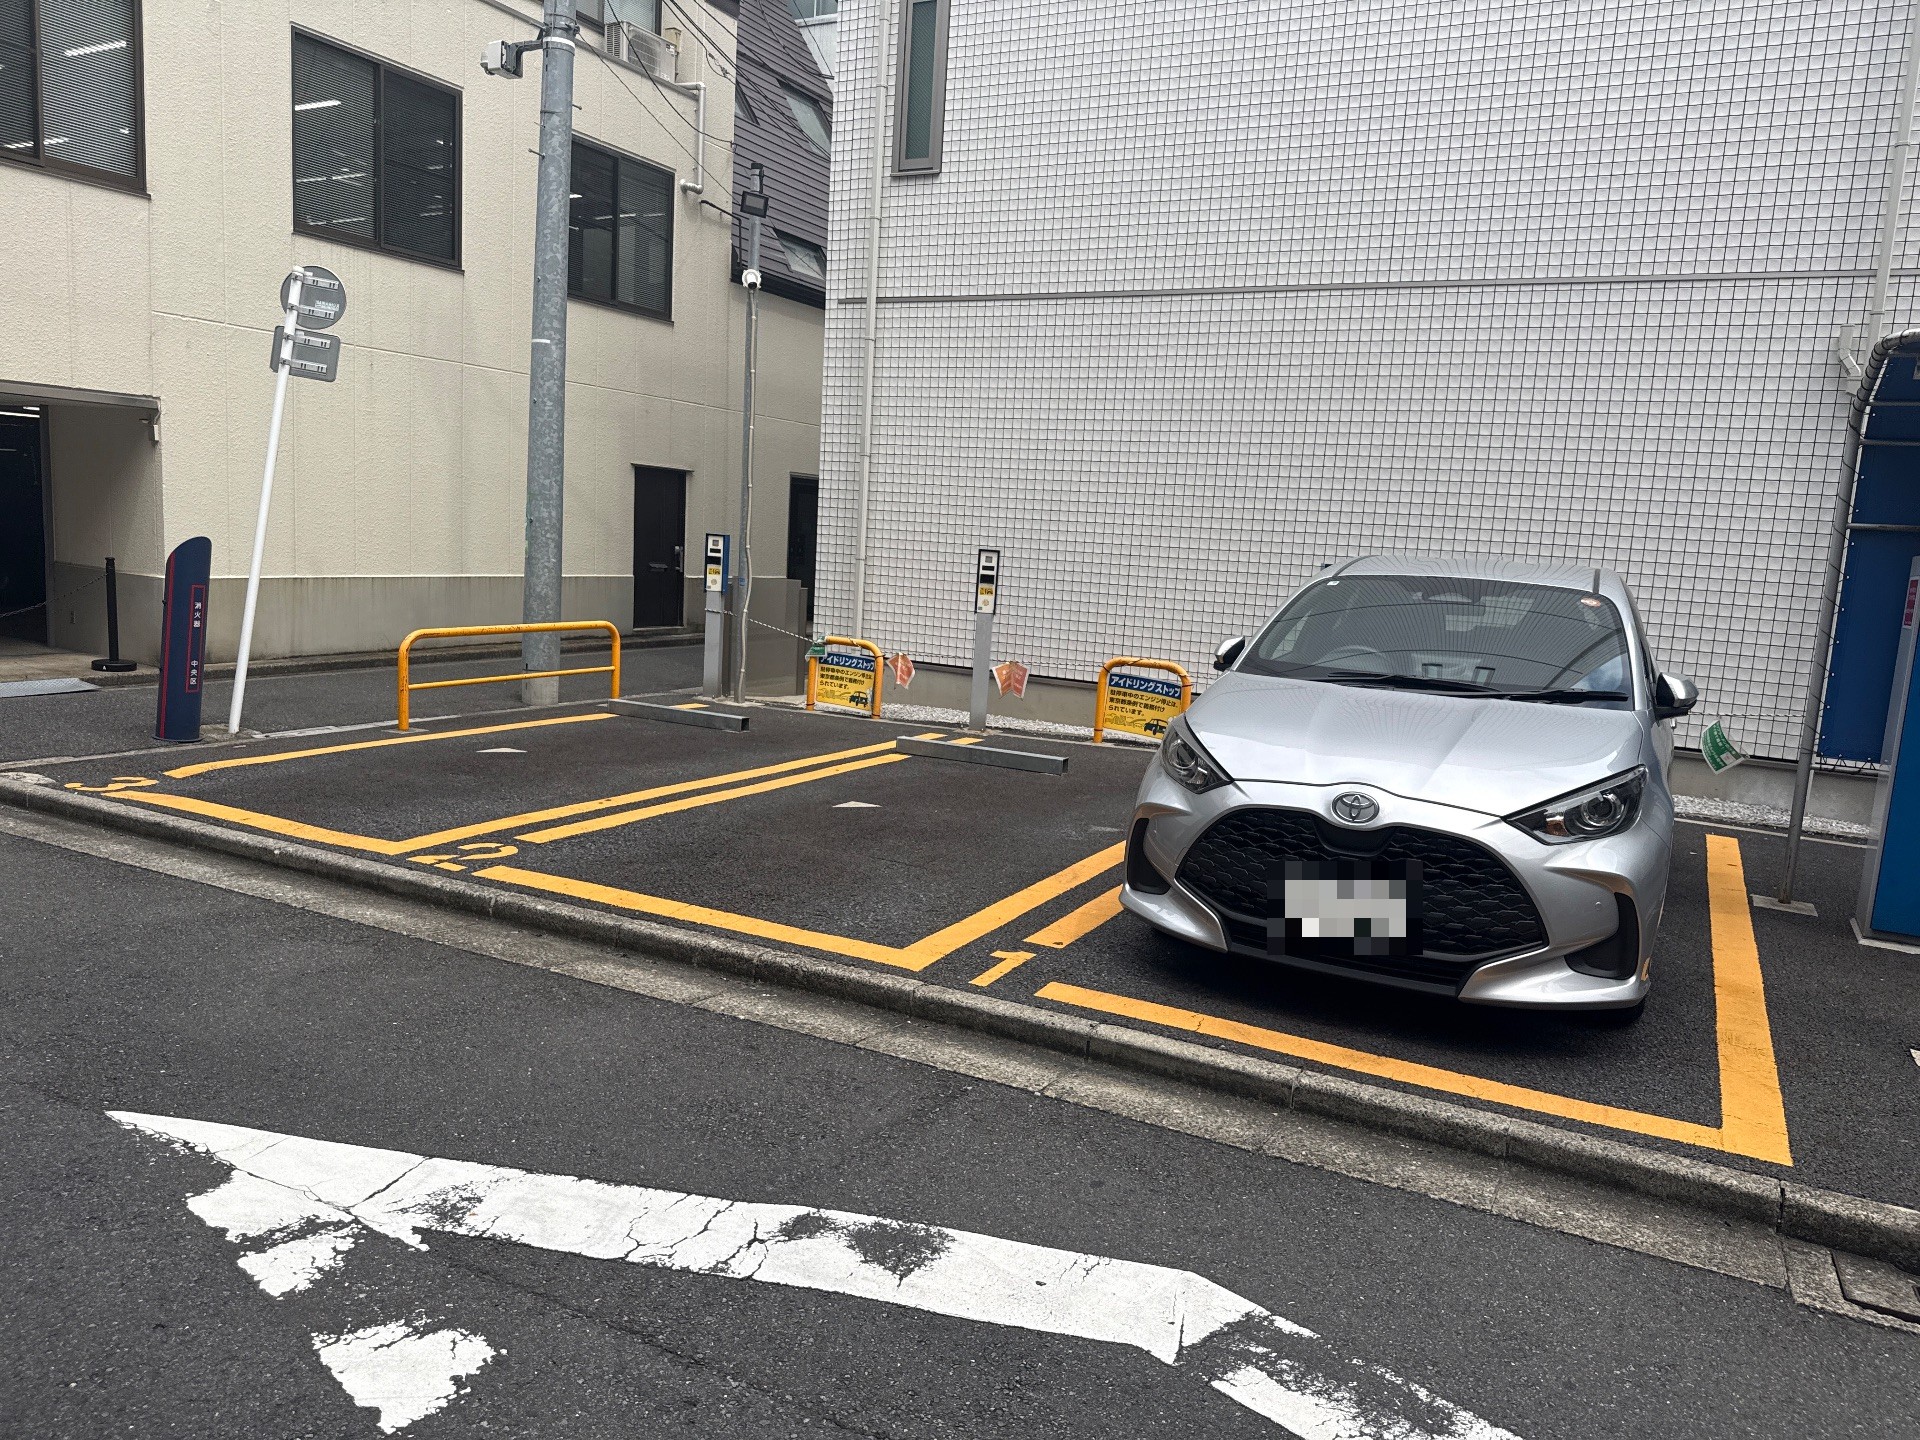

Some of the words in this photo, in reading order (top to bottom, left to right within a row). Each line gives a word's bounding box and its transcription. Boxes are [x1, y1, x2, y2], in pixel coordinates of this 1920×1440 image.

[190, 660, 199, 685] 中央区
[1110, 676, 1181, 698] アイドリングストップ
[1108, 704, 1145, 717] られています。
[64, 776, 159, 792] 3
[406, 843, 519, 872] 2
[967, 950, 1037, 987] 1
